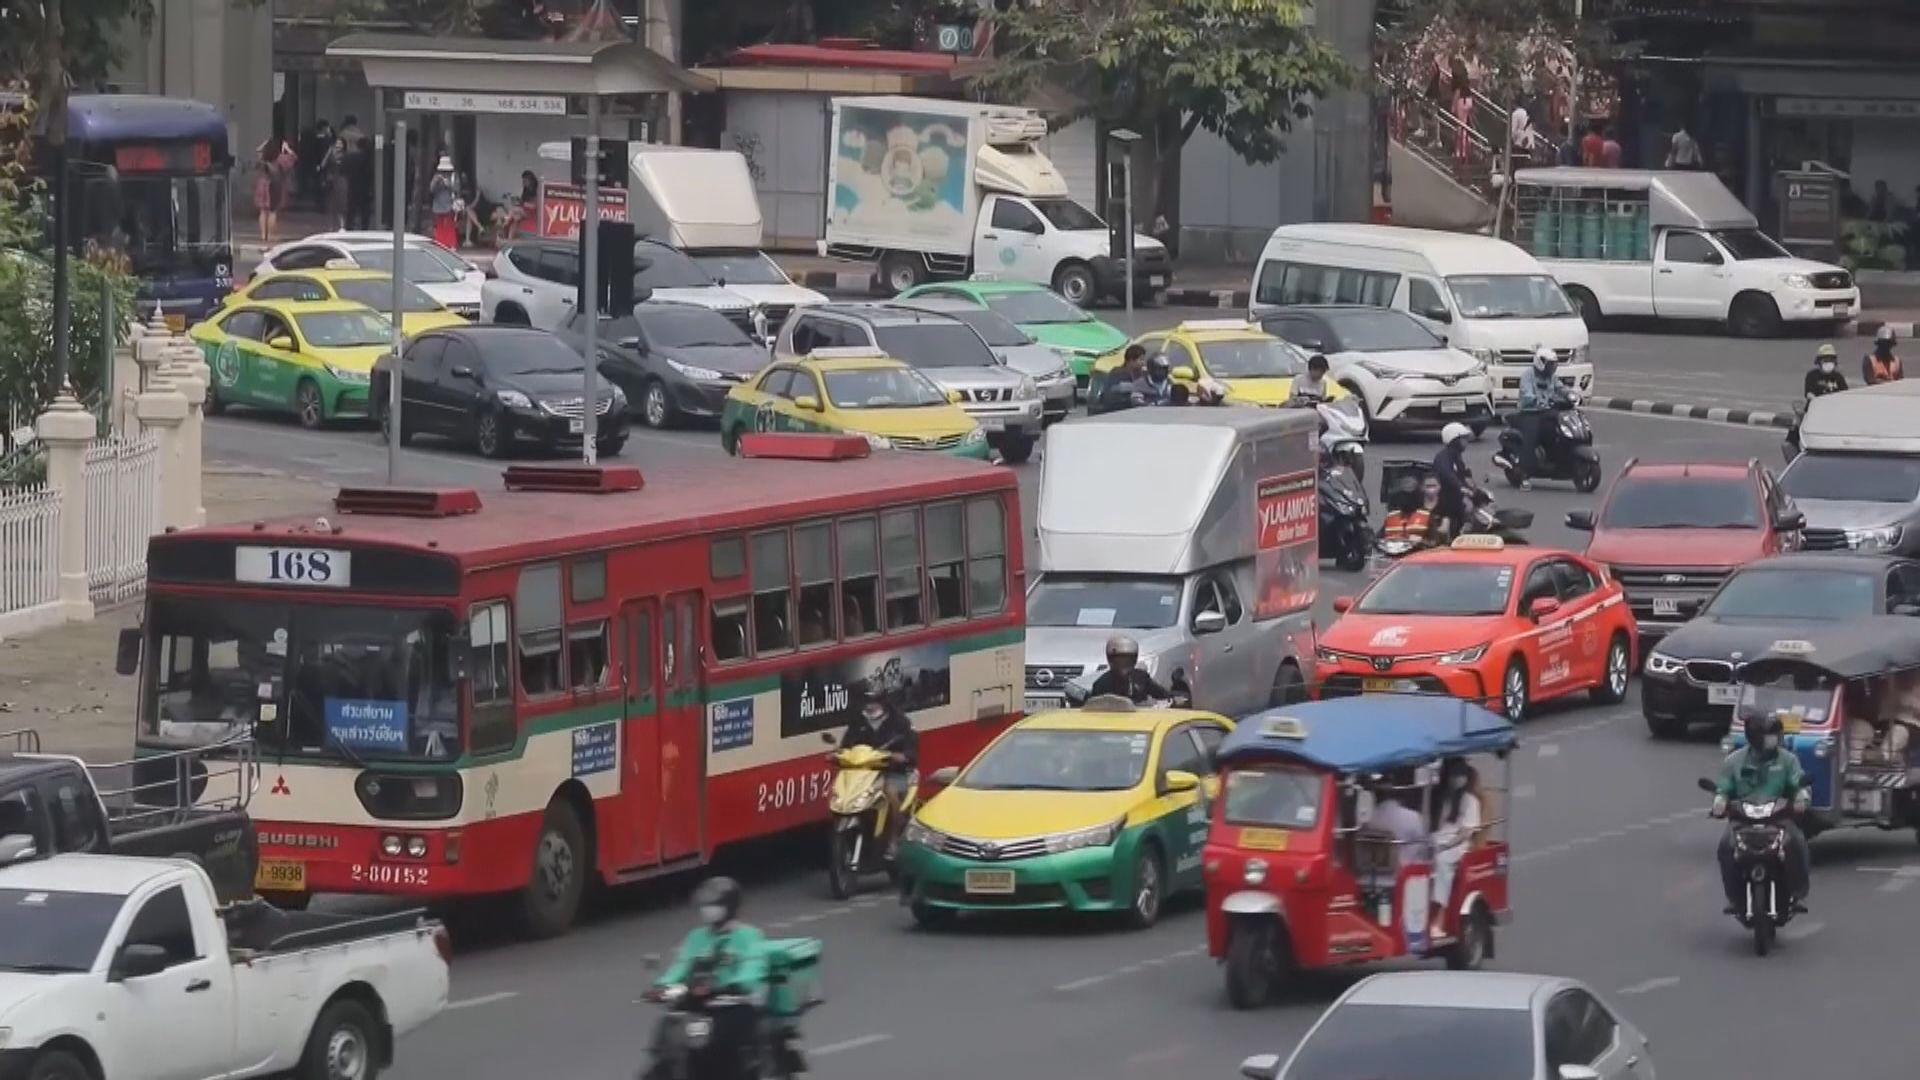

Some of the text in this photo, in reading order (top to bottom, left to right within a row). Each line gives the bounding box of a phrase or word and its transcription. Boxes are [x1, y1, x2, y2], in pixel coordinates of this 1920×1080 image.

[560, 203, 625, 223] LALOVE
[1270, 494, 1316, 526] LALAMOVE
[267, 550, 332, 582] 168
[800, 681, 849, 718] ดื่ม...ไม่ขับ
[757, 769, 832, 813] 2-80152
[257, 831, 339, 848] SUBISHI
[351, 863, 429, 885] 2-80152
